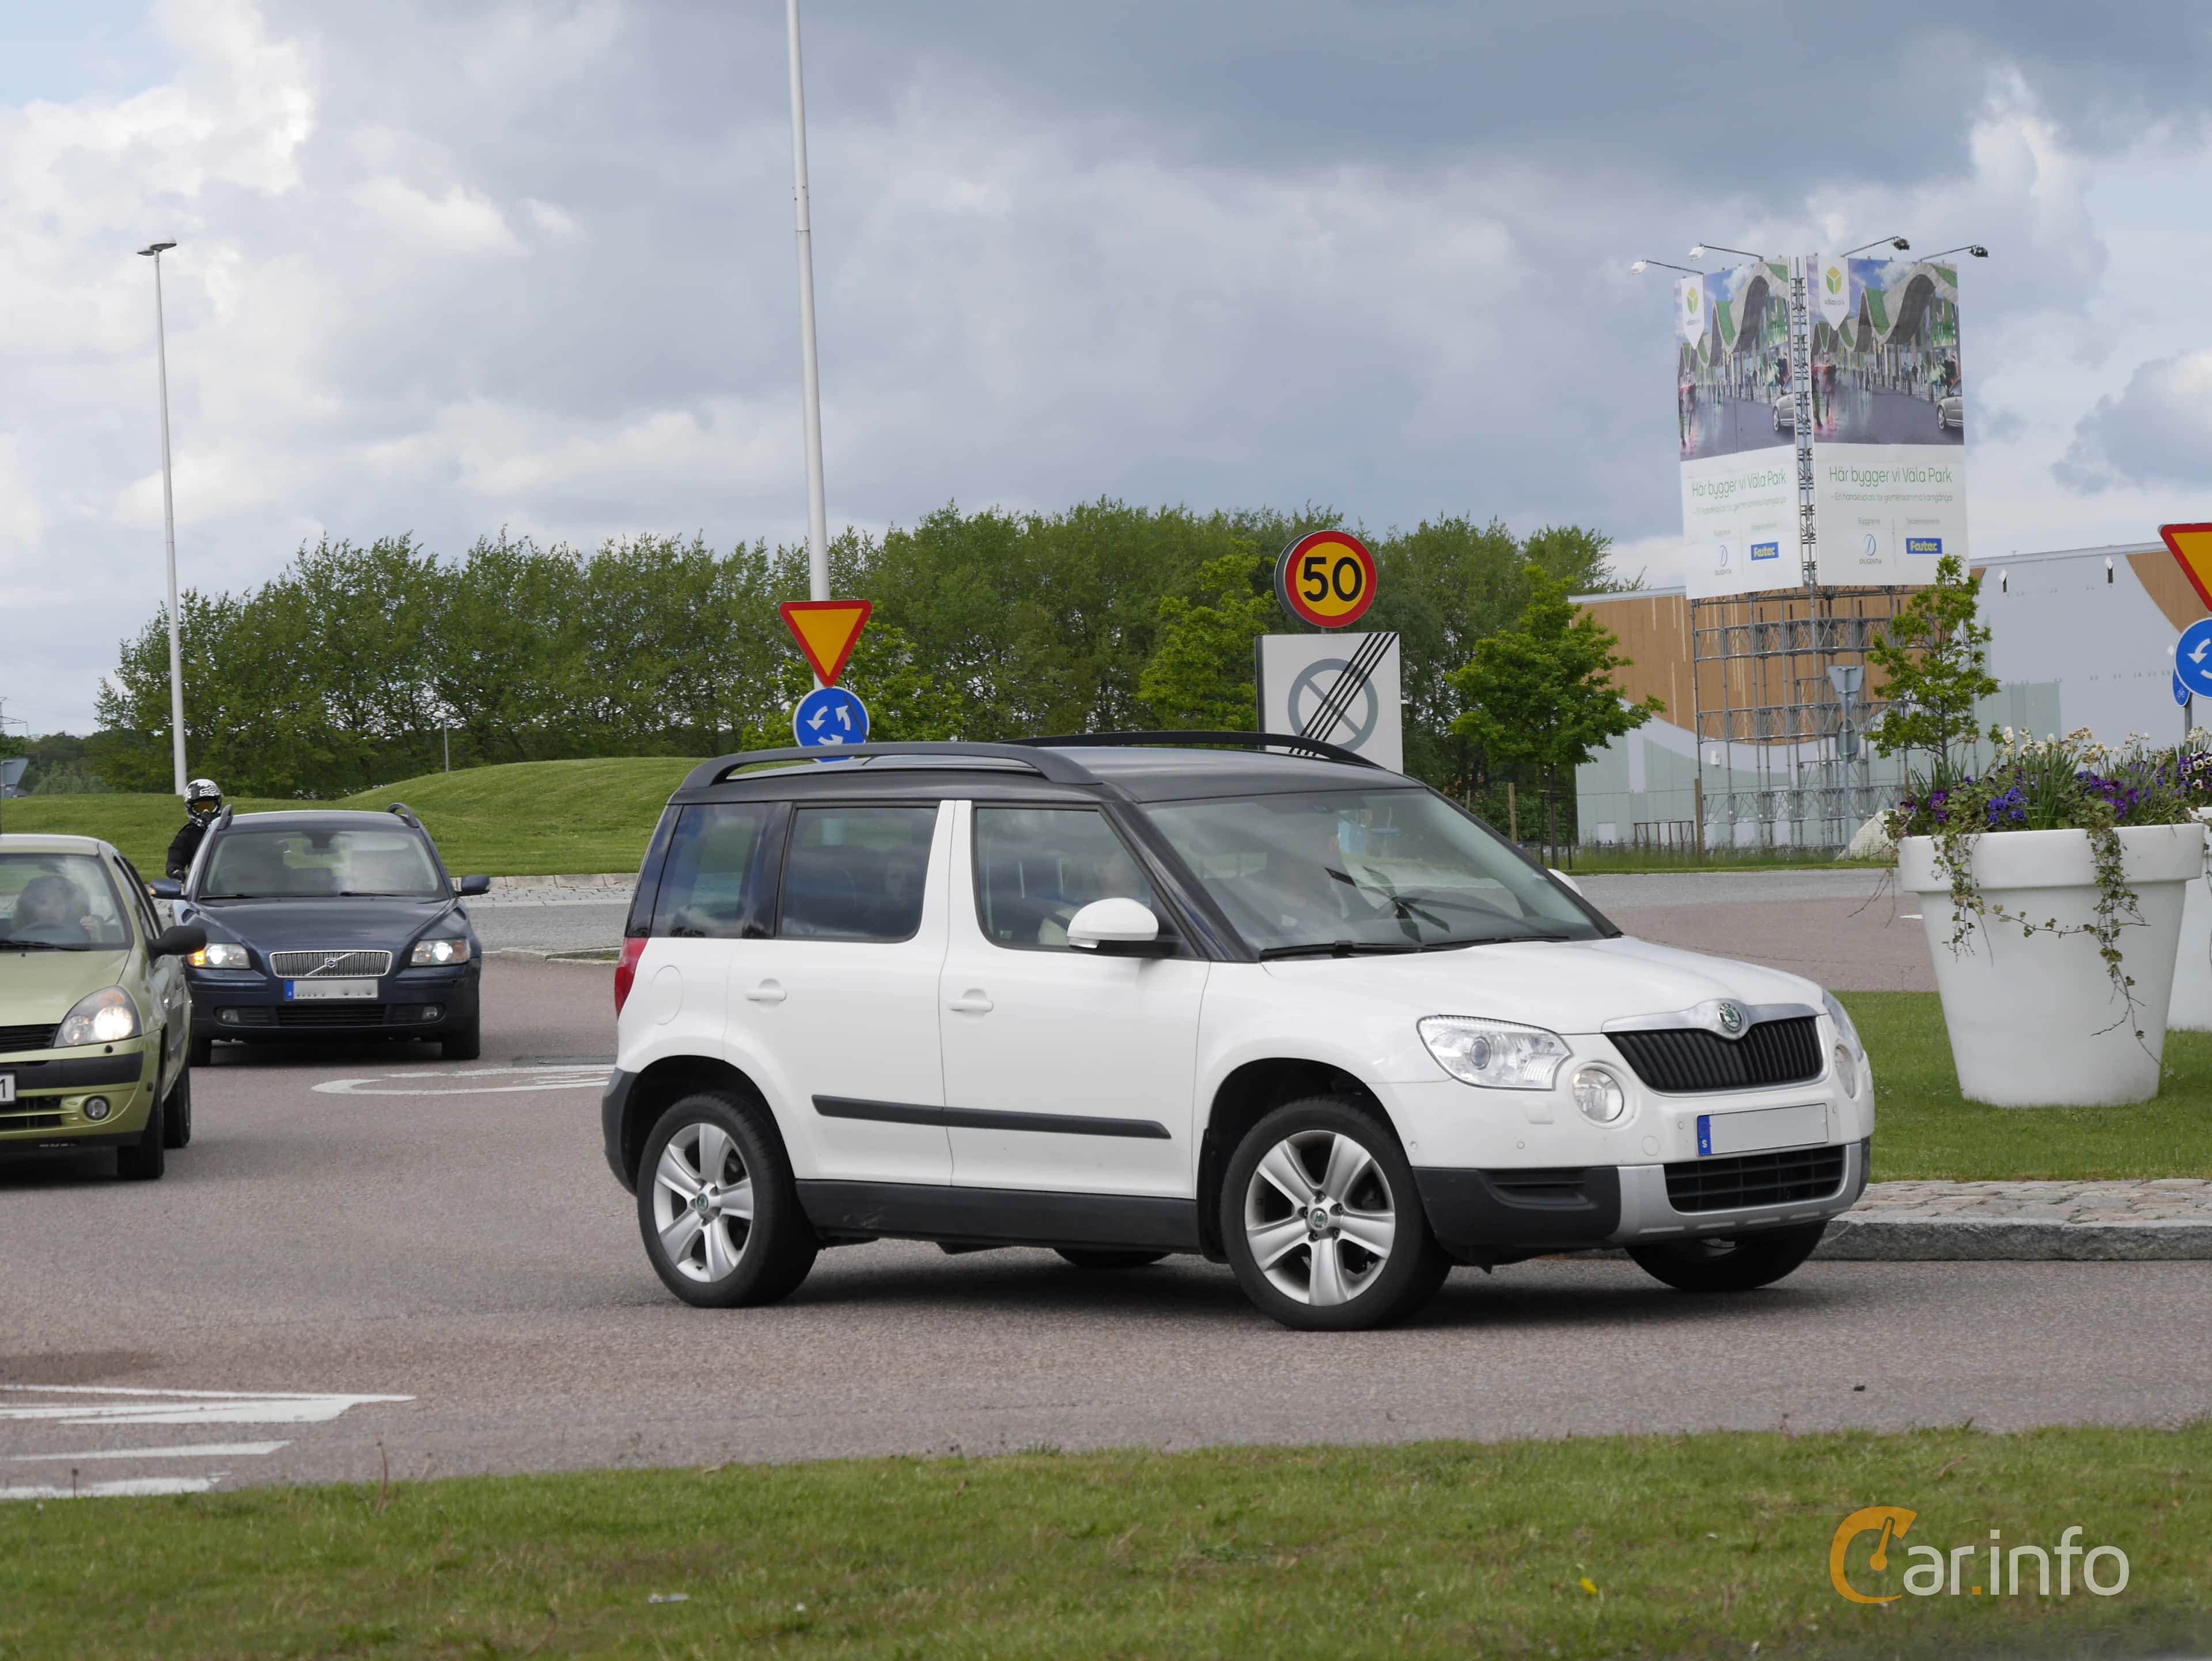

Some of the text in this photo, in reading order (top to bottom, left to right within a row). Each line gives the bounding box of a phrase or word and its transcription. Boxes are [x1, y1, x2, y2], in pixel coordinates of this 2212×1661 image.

[1708, 479, 1737, 500] bygger
[1738, 475, 1747, 490] vi
[1767, 468, 1786, 486] Park
[1829, 466, 1953, 487] Här bygger vi Väla Park
[1753, 546, 1776, 558] Fastec
[1910, 540, 1938, 552] Fastec
[1302, 556, 1363, 603] 50
[1702, 1139, 1708, 1148] S
